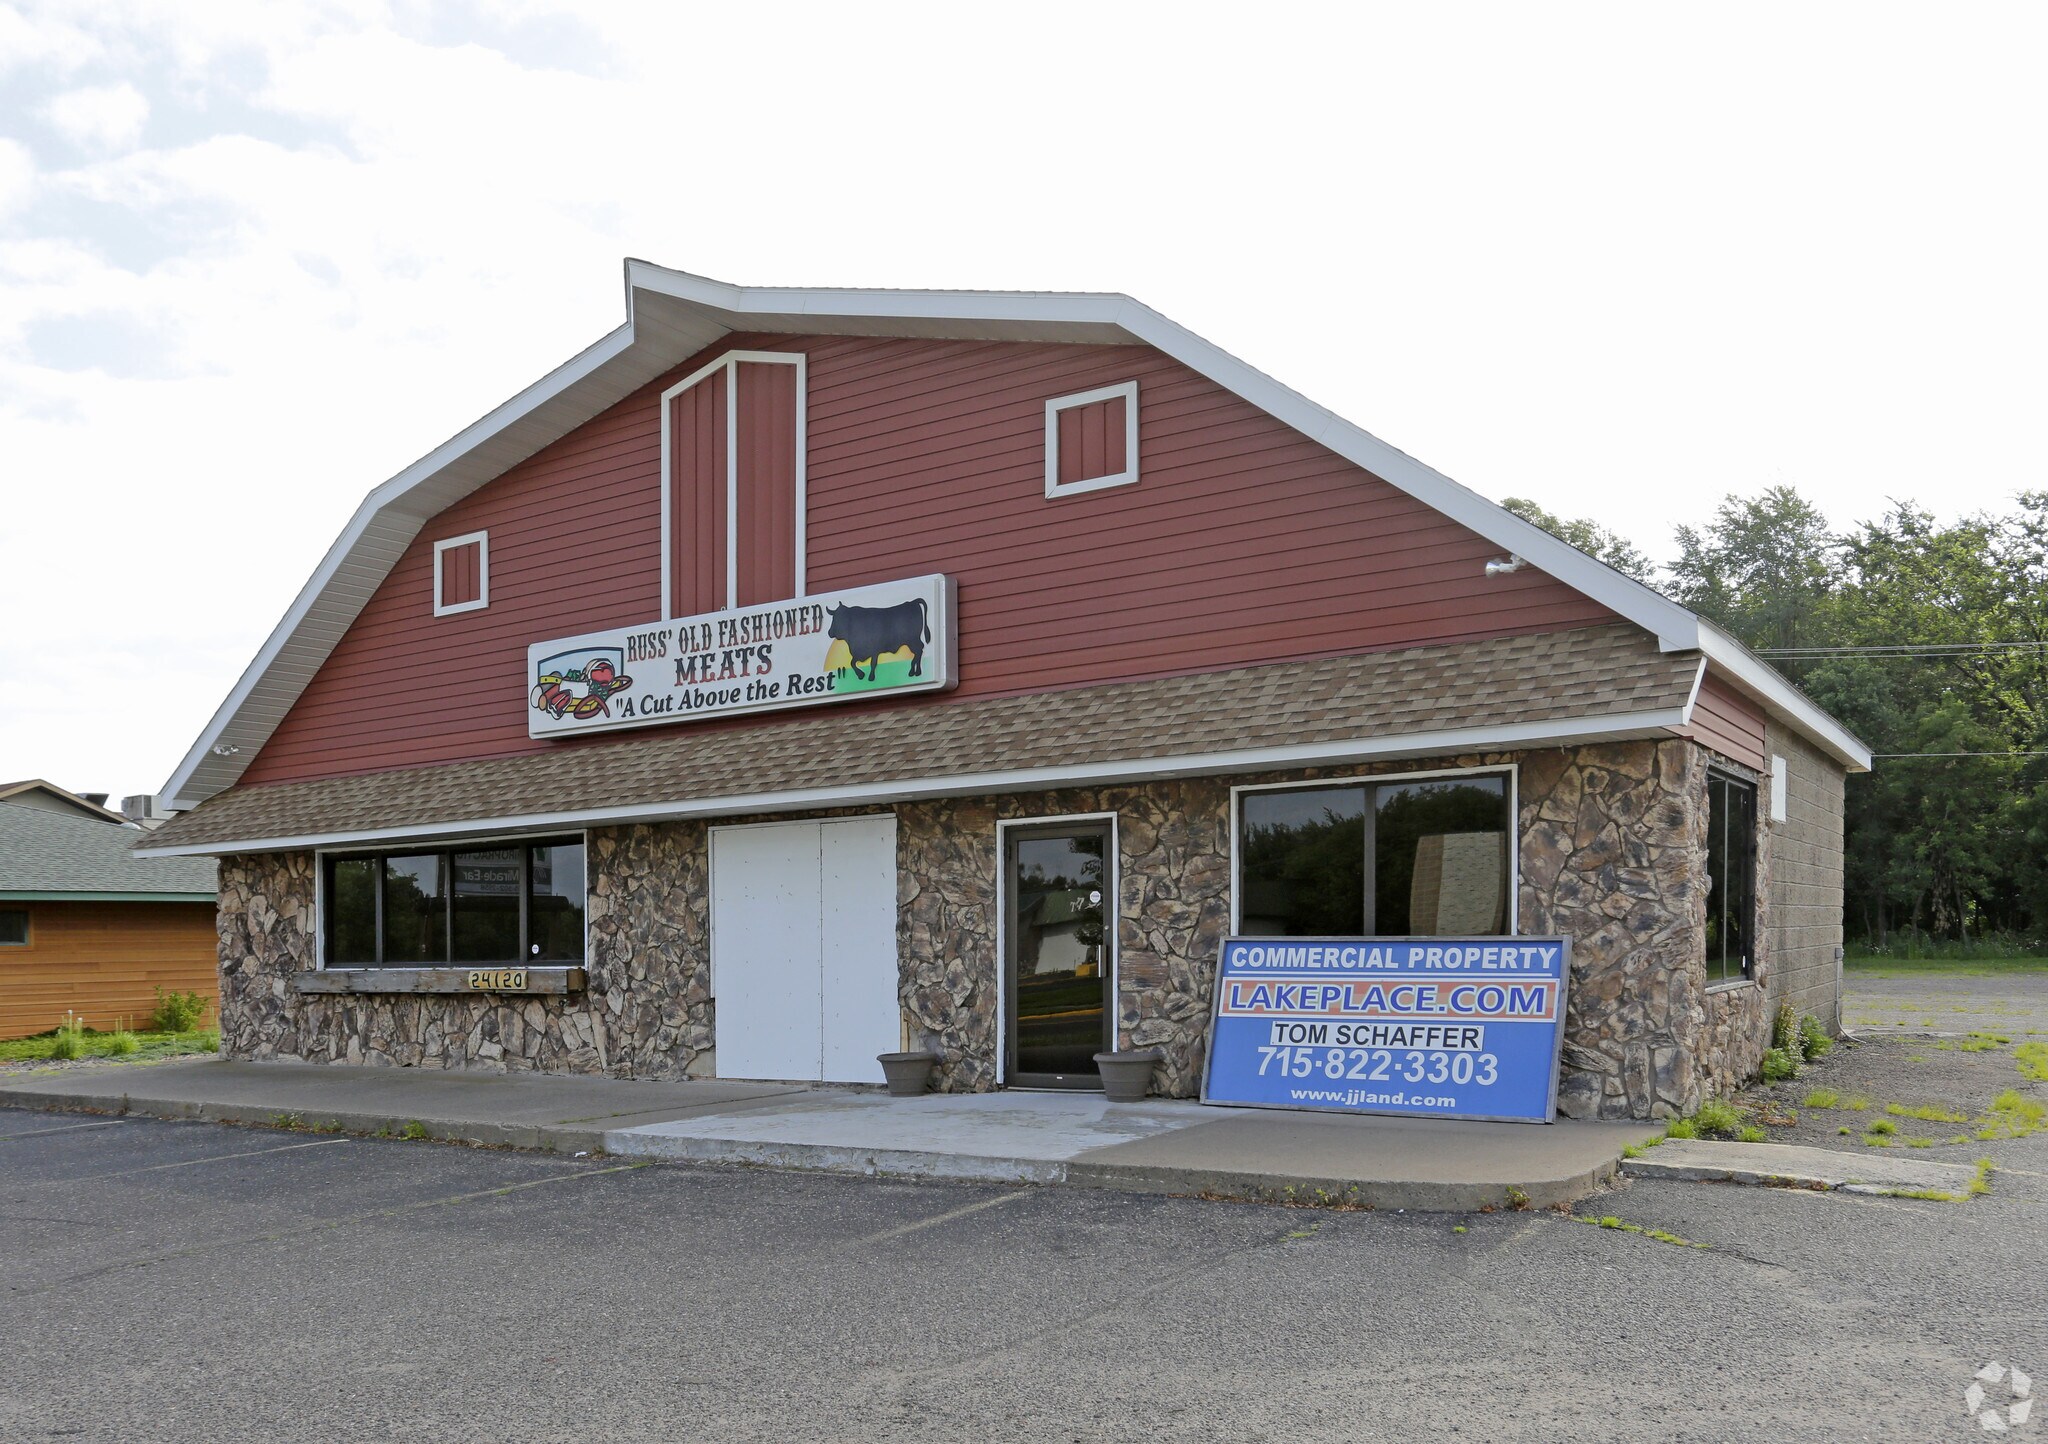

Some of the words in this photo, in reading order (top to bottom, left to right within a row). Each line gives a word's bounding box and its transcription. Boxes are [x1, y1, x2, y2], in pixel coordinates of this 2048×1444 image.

[627, 629, 672, 662] RUSS'
[678, 623, 713, 654] OLD
[718, 604, 824, 648] FASHIONED
[674, 644, 773, 687] MEATS
[616, 697, 636, 718] "A
[640, 693, 673, 715] Cut
[678, 687, 741, 711] Above
[746, 679, 780, 701] the
[786, 667, 846, 696] Rest"
[1231, 947, 1399, 969] COMMERCIAL
[1407, 947, 1558, 970] PROPERTY
[471, 972, 523, 988] 24120
[1228, 983, 1548, 1015] LAKEPLACE.COM
[1275, 1023, 1328, 1044] TOM
[1336, 1025, 1480, 1049] SCHAFFER
[1291, 1089, 1456, 1107] www.jjland.com
